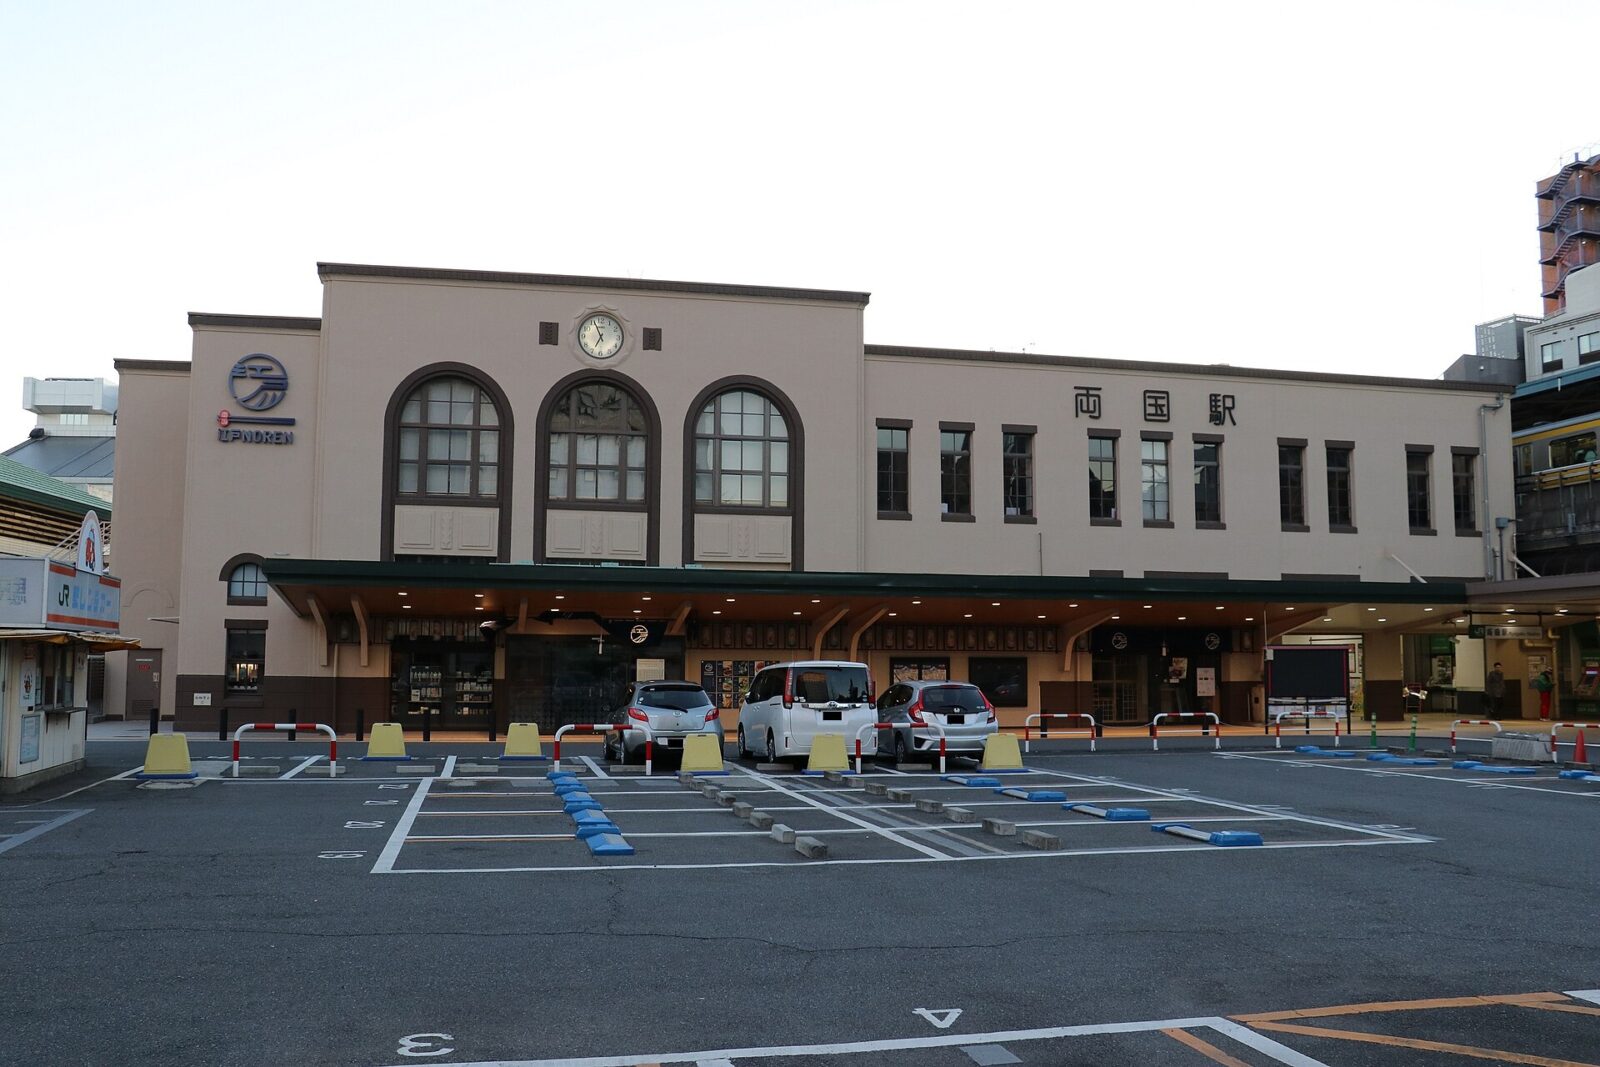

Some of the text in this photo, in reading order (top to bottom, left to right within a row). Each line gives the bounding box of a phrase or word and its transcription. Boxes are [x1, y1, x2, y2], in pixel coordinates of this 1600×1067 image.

[1073, 386, 1237, 426] 両国駅
[58, 584, 70, 607] JR
[343, 820, 386, 829] 20
[317, 850, 368, 859] 19
[911, 1008, 963, 1028] 4
[397, 1033, 455, 1057] 3
